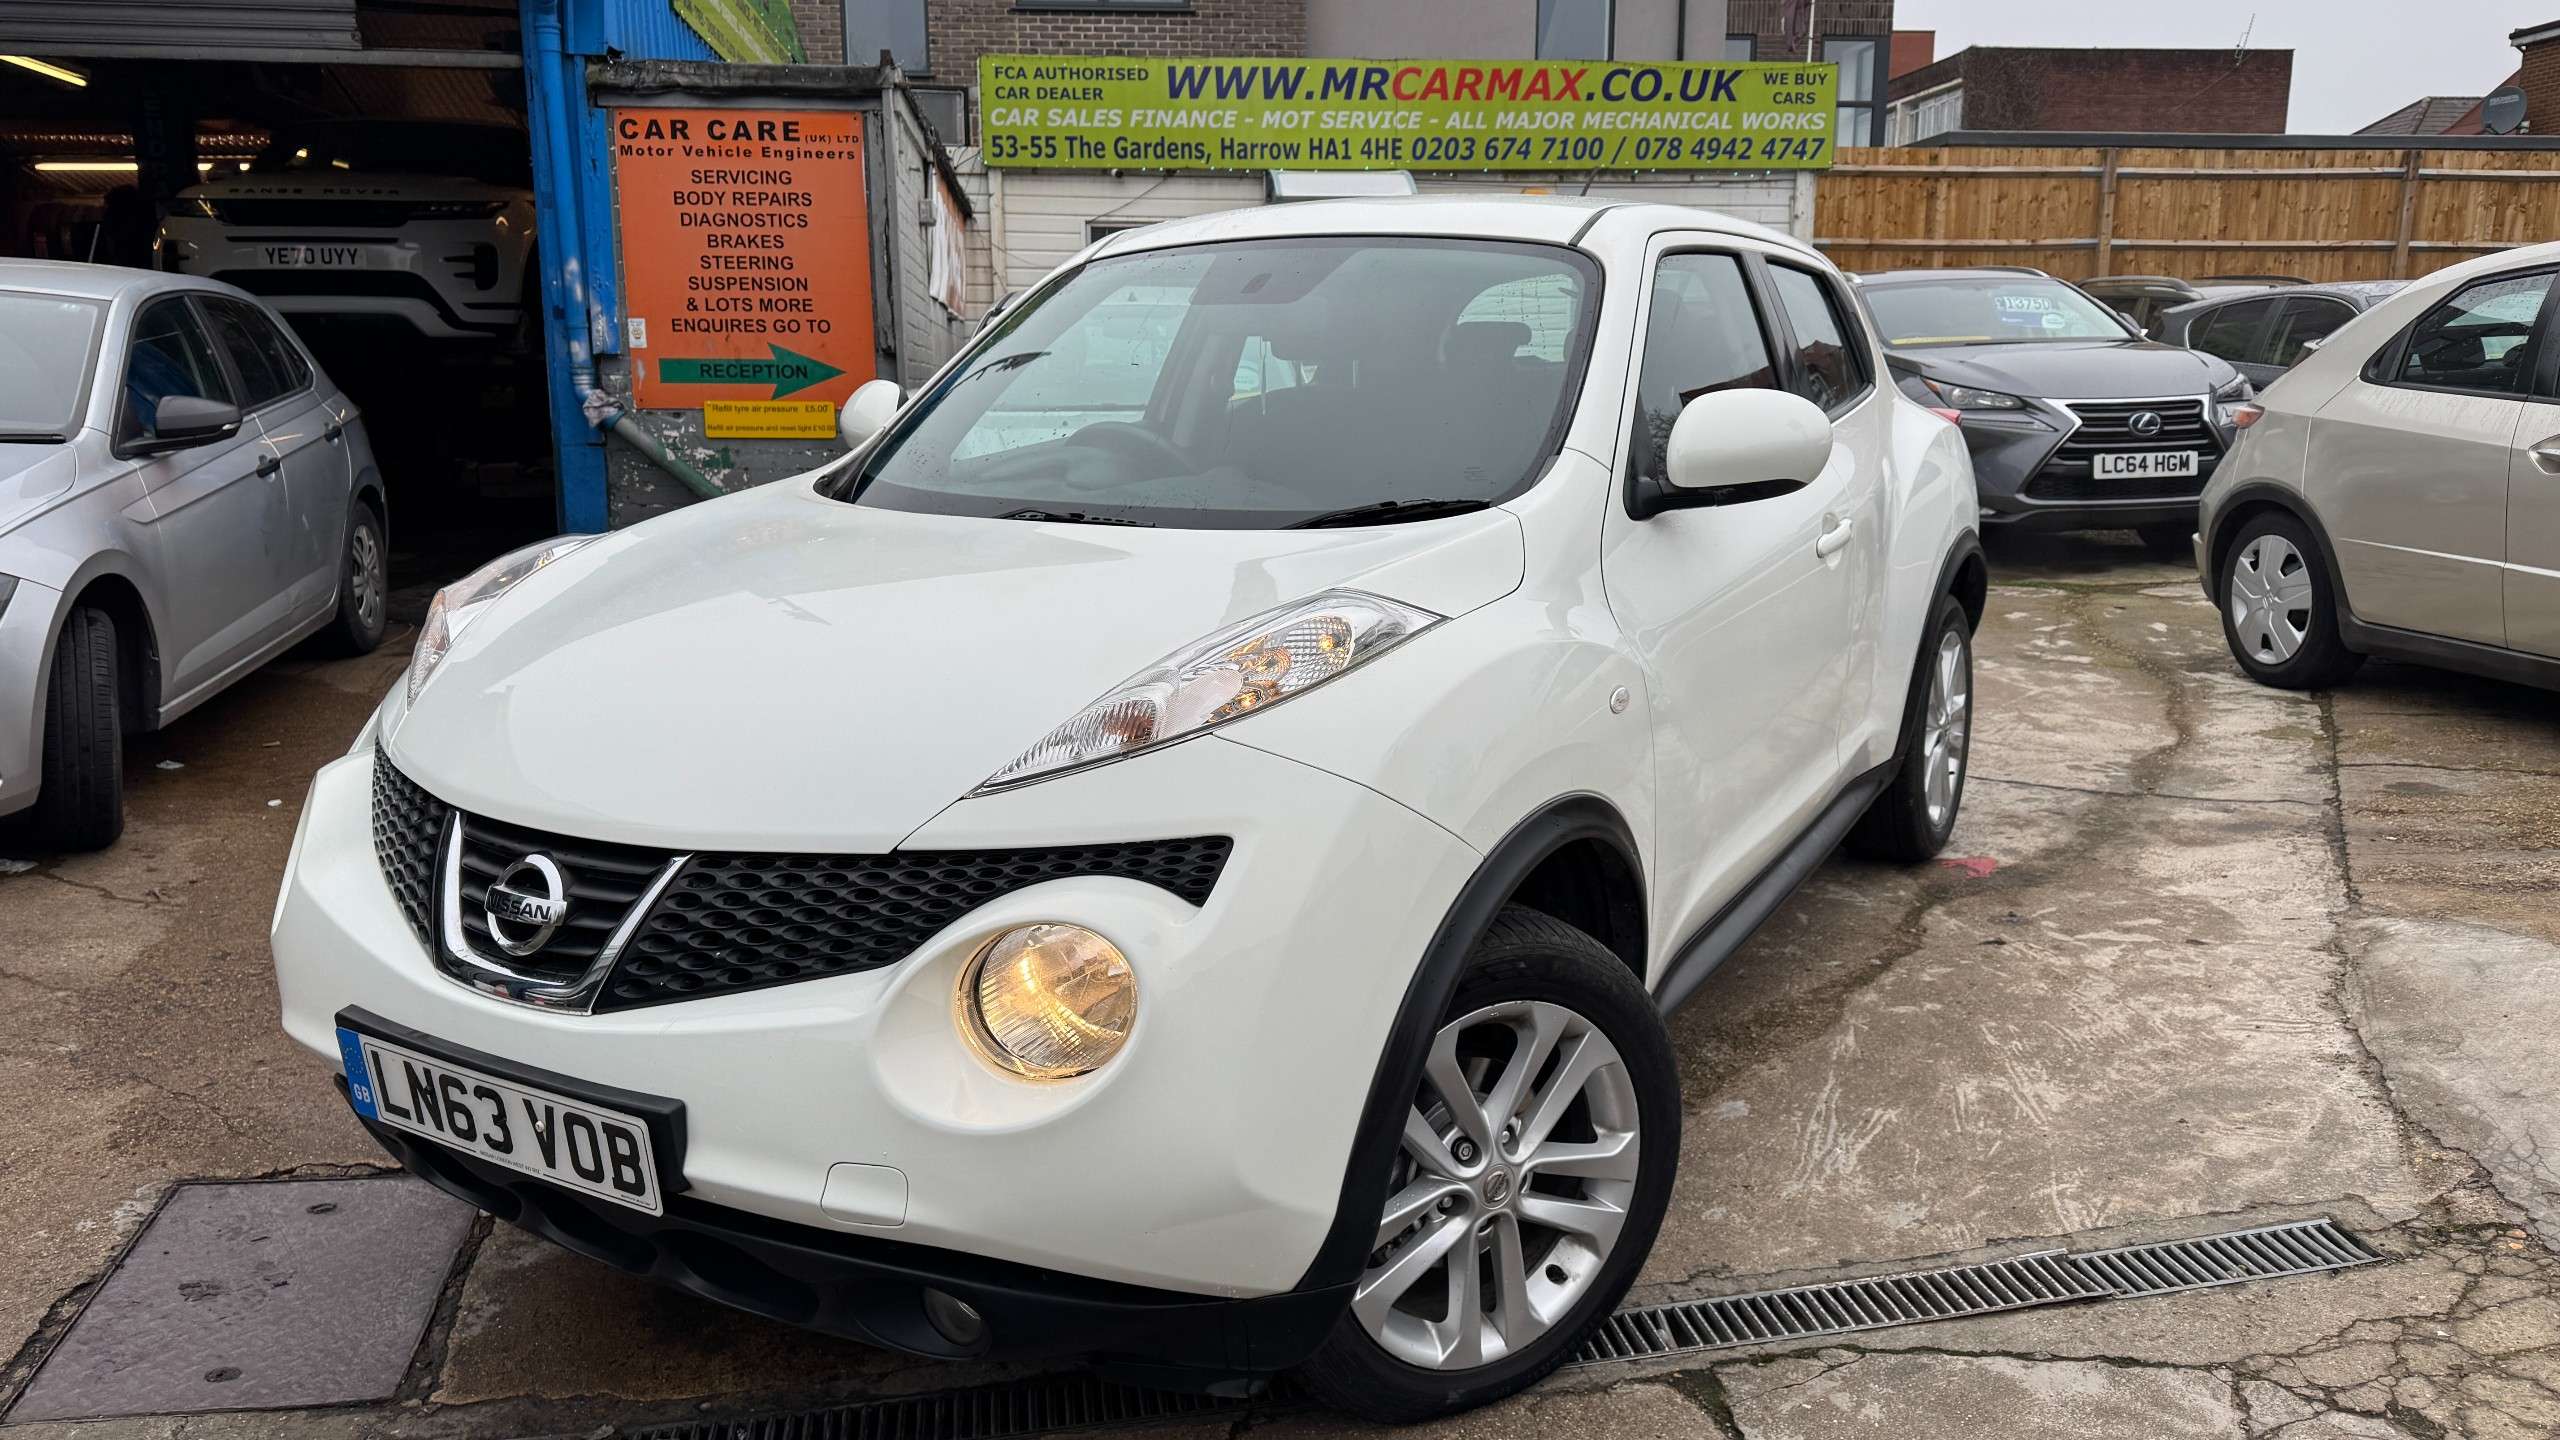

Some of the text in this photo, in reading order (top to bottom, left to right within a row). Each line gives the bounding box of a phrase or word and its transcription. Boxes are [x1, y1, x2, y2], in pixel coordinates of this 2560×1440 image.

[994, 66, 1149, 81] FCA AUTHORISED
[1763, 72, 1828, 86] WE BUY
[1167, 65, 1744, 102] WWW.MRCARMAX.CO.UK
[995, 87, 1104, 101] CAR DEALER
[1772, 92, 1816, 105] CARS
[990, 108, 1038, 127] CAR
[1046, 108, 1122, 128] SALES
[1129, 109, 1237, 129] FINANCE
[1261, 110, 1315, 130] MOT
[1319, 111, 1421, 130] SERVICE
[1444, 111, 1488, 130] ALL
[1495, 111, 1576, 130] MAJOR
[1582, 112, 1733, 130] MECHANICAL
[1741, 112, 1827, 130] WORKS
[619, 118, 859, 145] CAR CARE (UK) LTD
[620, 144, 855, 161] Motor Vehicle Engineers
[991, 135, 1826, 165] 53-55 The Gardens, Harrow HA1 4HE 0203 674 7100 / 078 4942 4747
[691, 170, 792, 185] SERVICING
[673, 191, 812, 207] BODY REPAIRS
[680, 212, 808, 228] DIAGNOSTICS
[707, 234, 785, 249] BRAKES
[265, 247, 358, 265] YE70 UYY
[700, 255, 794, 271] STEERING
[688, 276, 808, 292] SUSPENSION
[686, 298, 813, 313] & LOTS MORE
[671, 318, 832, 334] ENQUIRES GO TO
[700, 364, 808, 380] RECEPTION
[2102, 454, 2191, 474] LC64 HGM
[352, 1083, 371, 1103] GB
[371, 1049, 646, 1196] LN63 VOB
